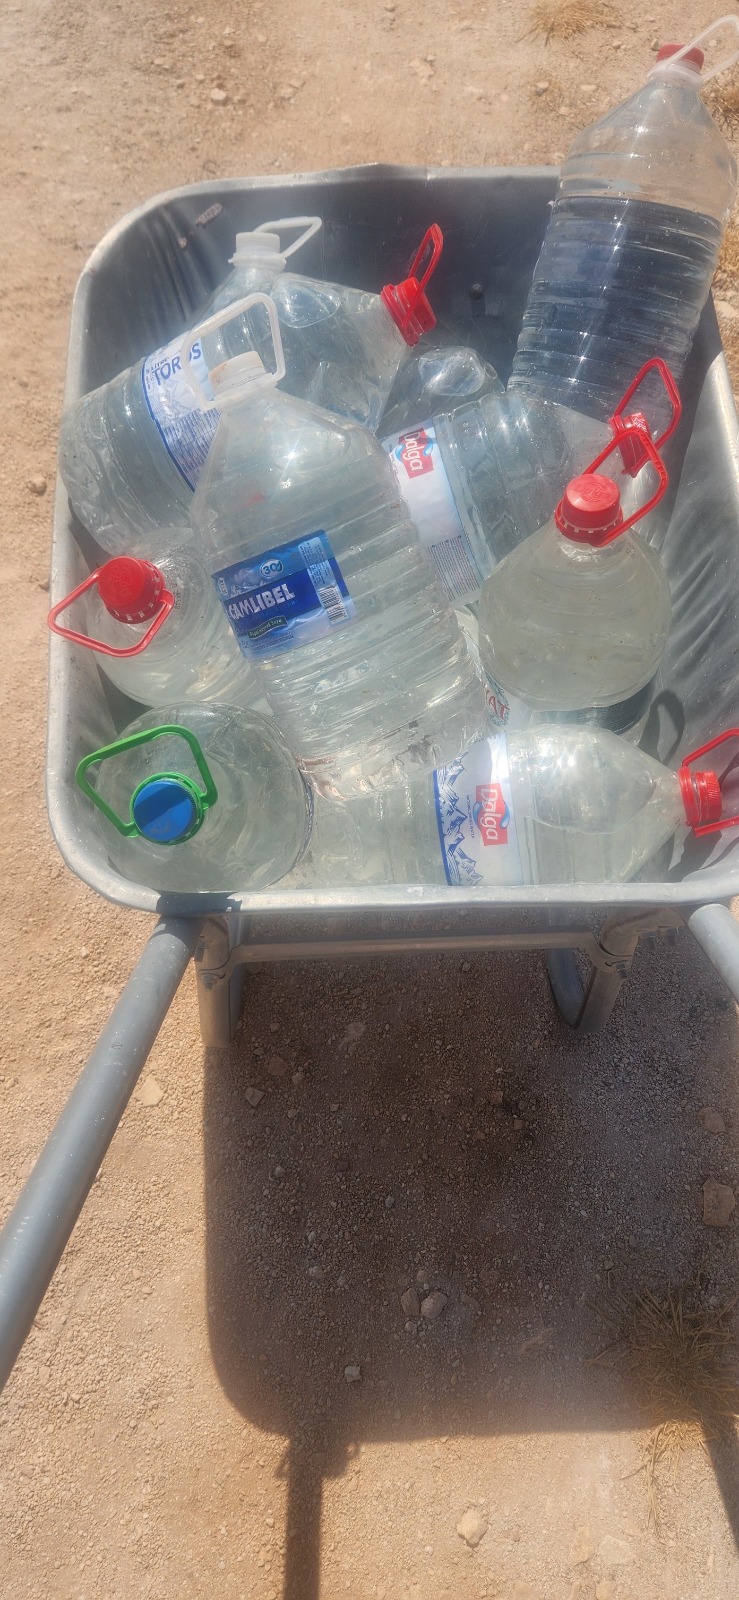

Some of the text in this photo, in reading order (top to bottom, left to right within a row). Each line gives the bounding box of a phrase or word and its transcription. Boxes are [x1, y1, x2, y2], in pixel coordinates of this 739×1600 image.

[402, 431, 424, 472] Dalga
[486, 690, 511, 720] AT
[481, 788, 501, 842] Dalga
